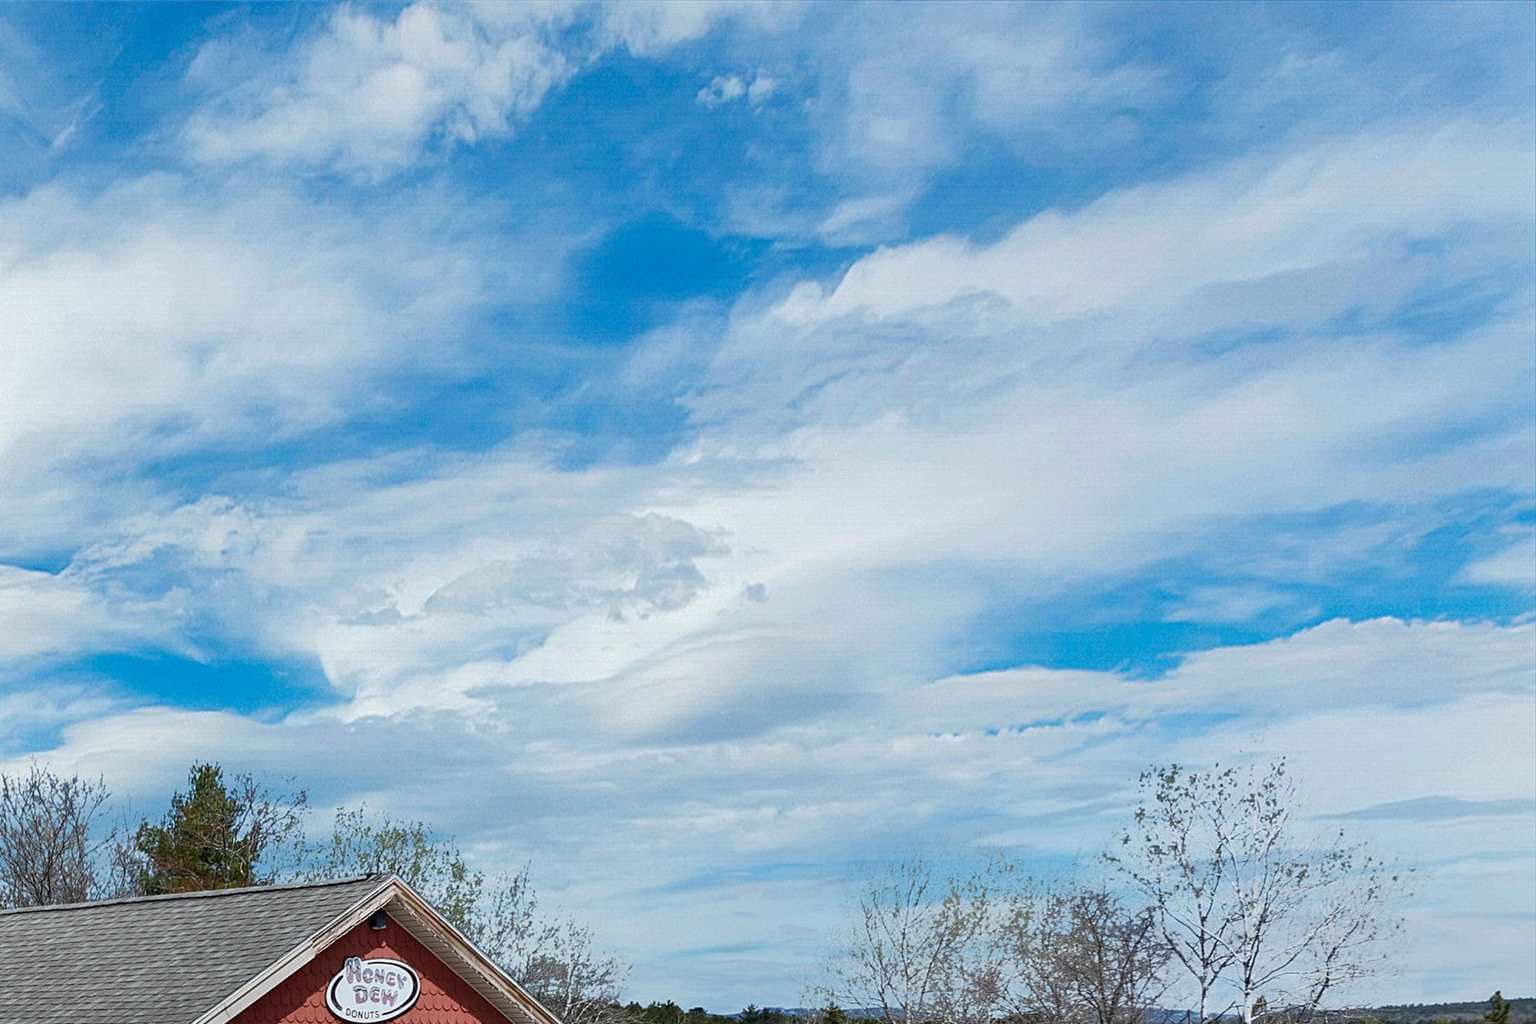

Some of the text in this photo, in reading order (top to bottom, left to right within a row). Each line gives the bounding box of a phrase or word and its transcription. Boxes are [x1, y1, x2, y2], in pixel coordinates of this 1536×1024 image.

[346, 958, 407, 989] HONEY
[353, 985, 398, 1007] DEW
[345, 1008, 380, 1020] DONUTS
